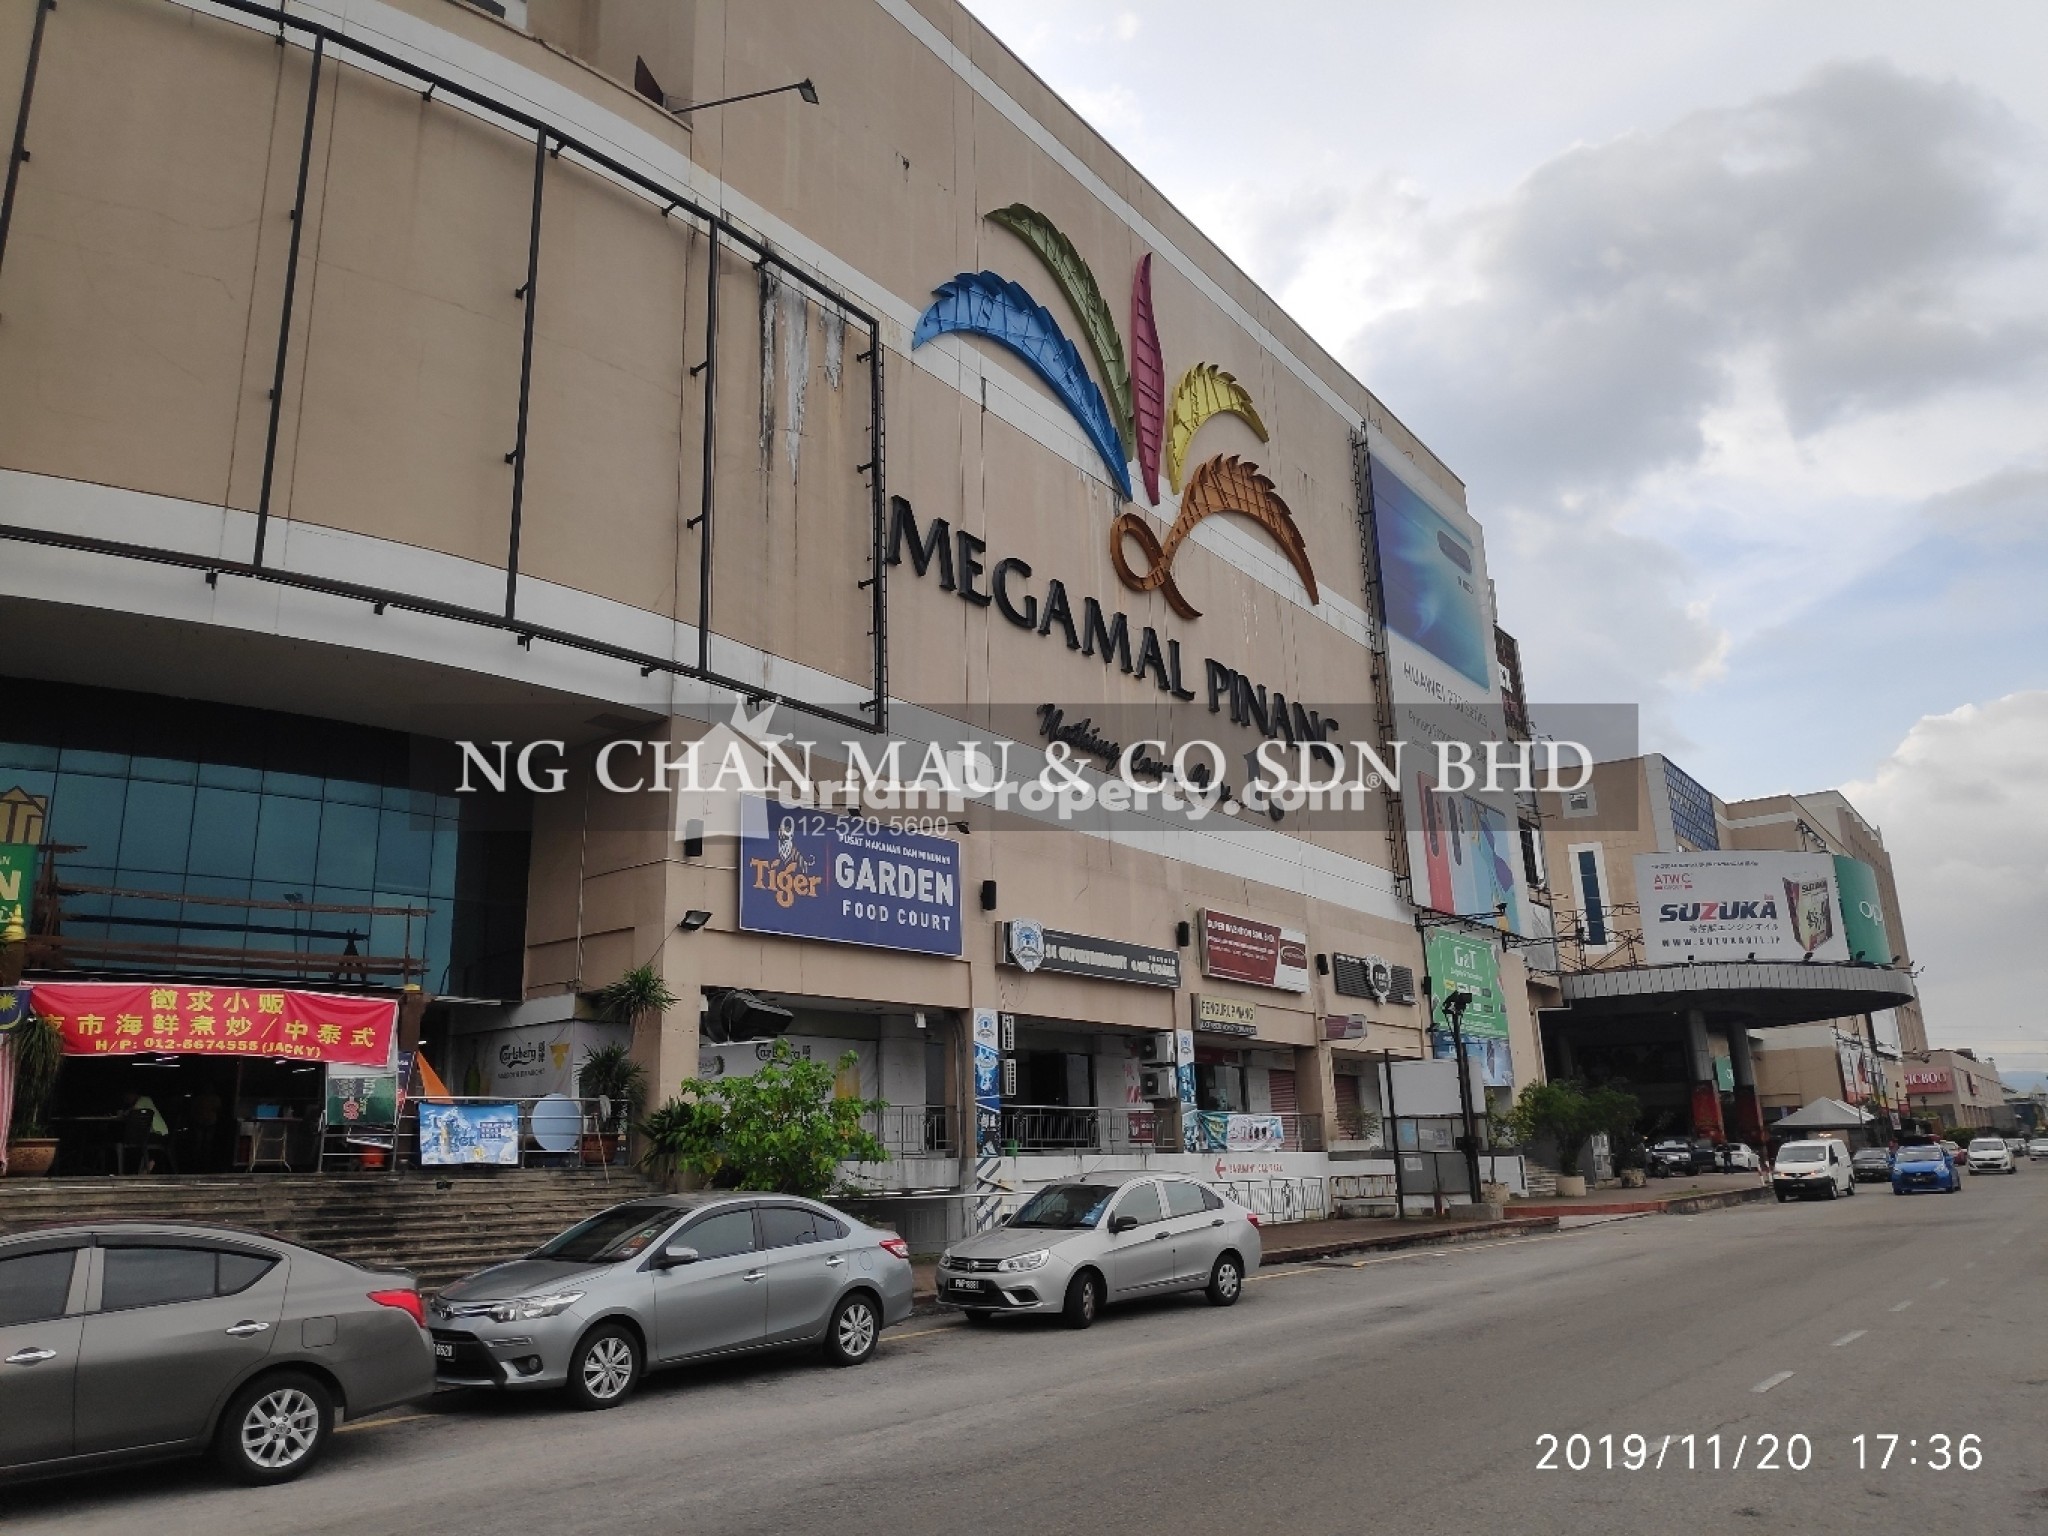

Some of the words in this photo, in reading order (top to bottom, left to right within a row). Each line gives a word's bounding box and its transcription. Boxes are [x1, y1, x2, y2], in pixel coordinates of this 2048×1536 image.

[887, 495, 1195, 701] MEGAMAL
[1205, 658, 1345, 770] PINANG
[1403, 661, 1446, 703] HUAWEI
[838, 833, 864, 848] PUSAT
[865, 839, 901, 855] MAKANAN
[750, 857, 822, 909] Tiger
[835, 853, 954, 907] GARDEN
[1654, 873, 1692, 885] ATWC
[842, 900, 889, 923] FOOD
[898, 909, 951, 932] COURT
[1659, 900, 1777, 923] SUZUKA
[95, 1040, 138, 1052] H/P:
[261, 1042, 322, 1059] (JACKY)
